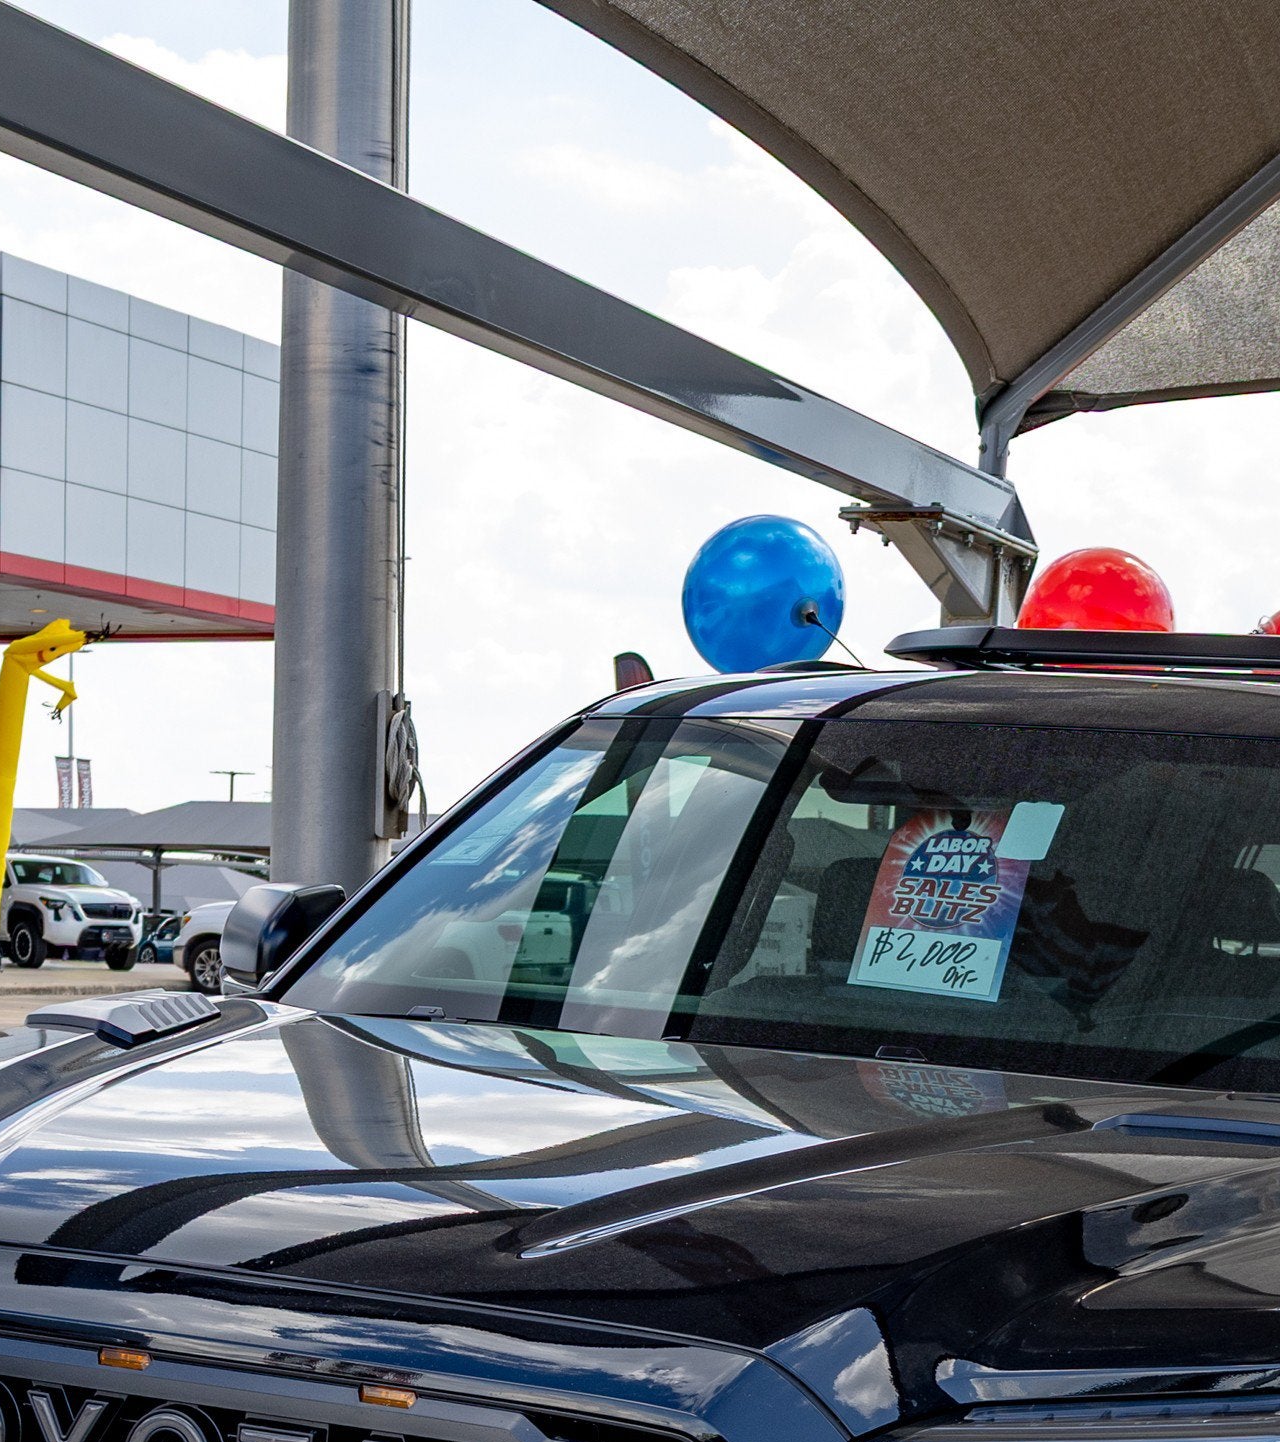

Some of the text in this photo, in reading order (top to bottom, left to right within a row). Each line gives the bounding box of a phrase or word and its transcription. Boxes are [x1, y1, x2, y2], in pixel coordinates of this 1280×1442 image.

[925, 838, 992, 853] LABOR
[926, 854, 980, 873] DAY
[895, 877, 1002, 904] SALES
[890, 897, 988, 923] BLITZ
[869, 927, 978, 972] $2,000
